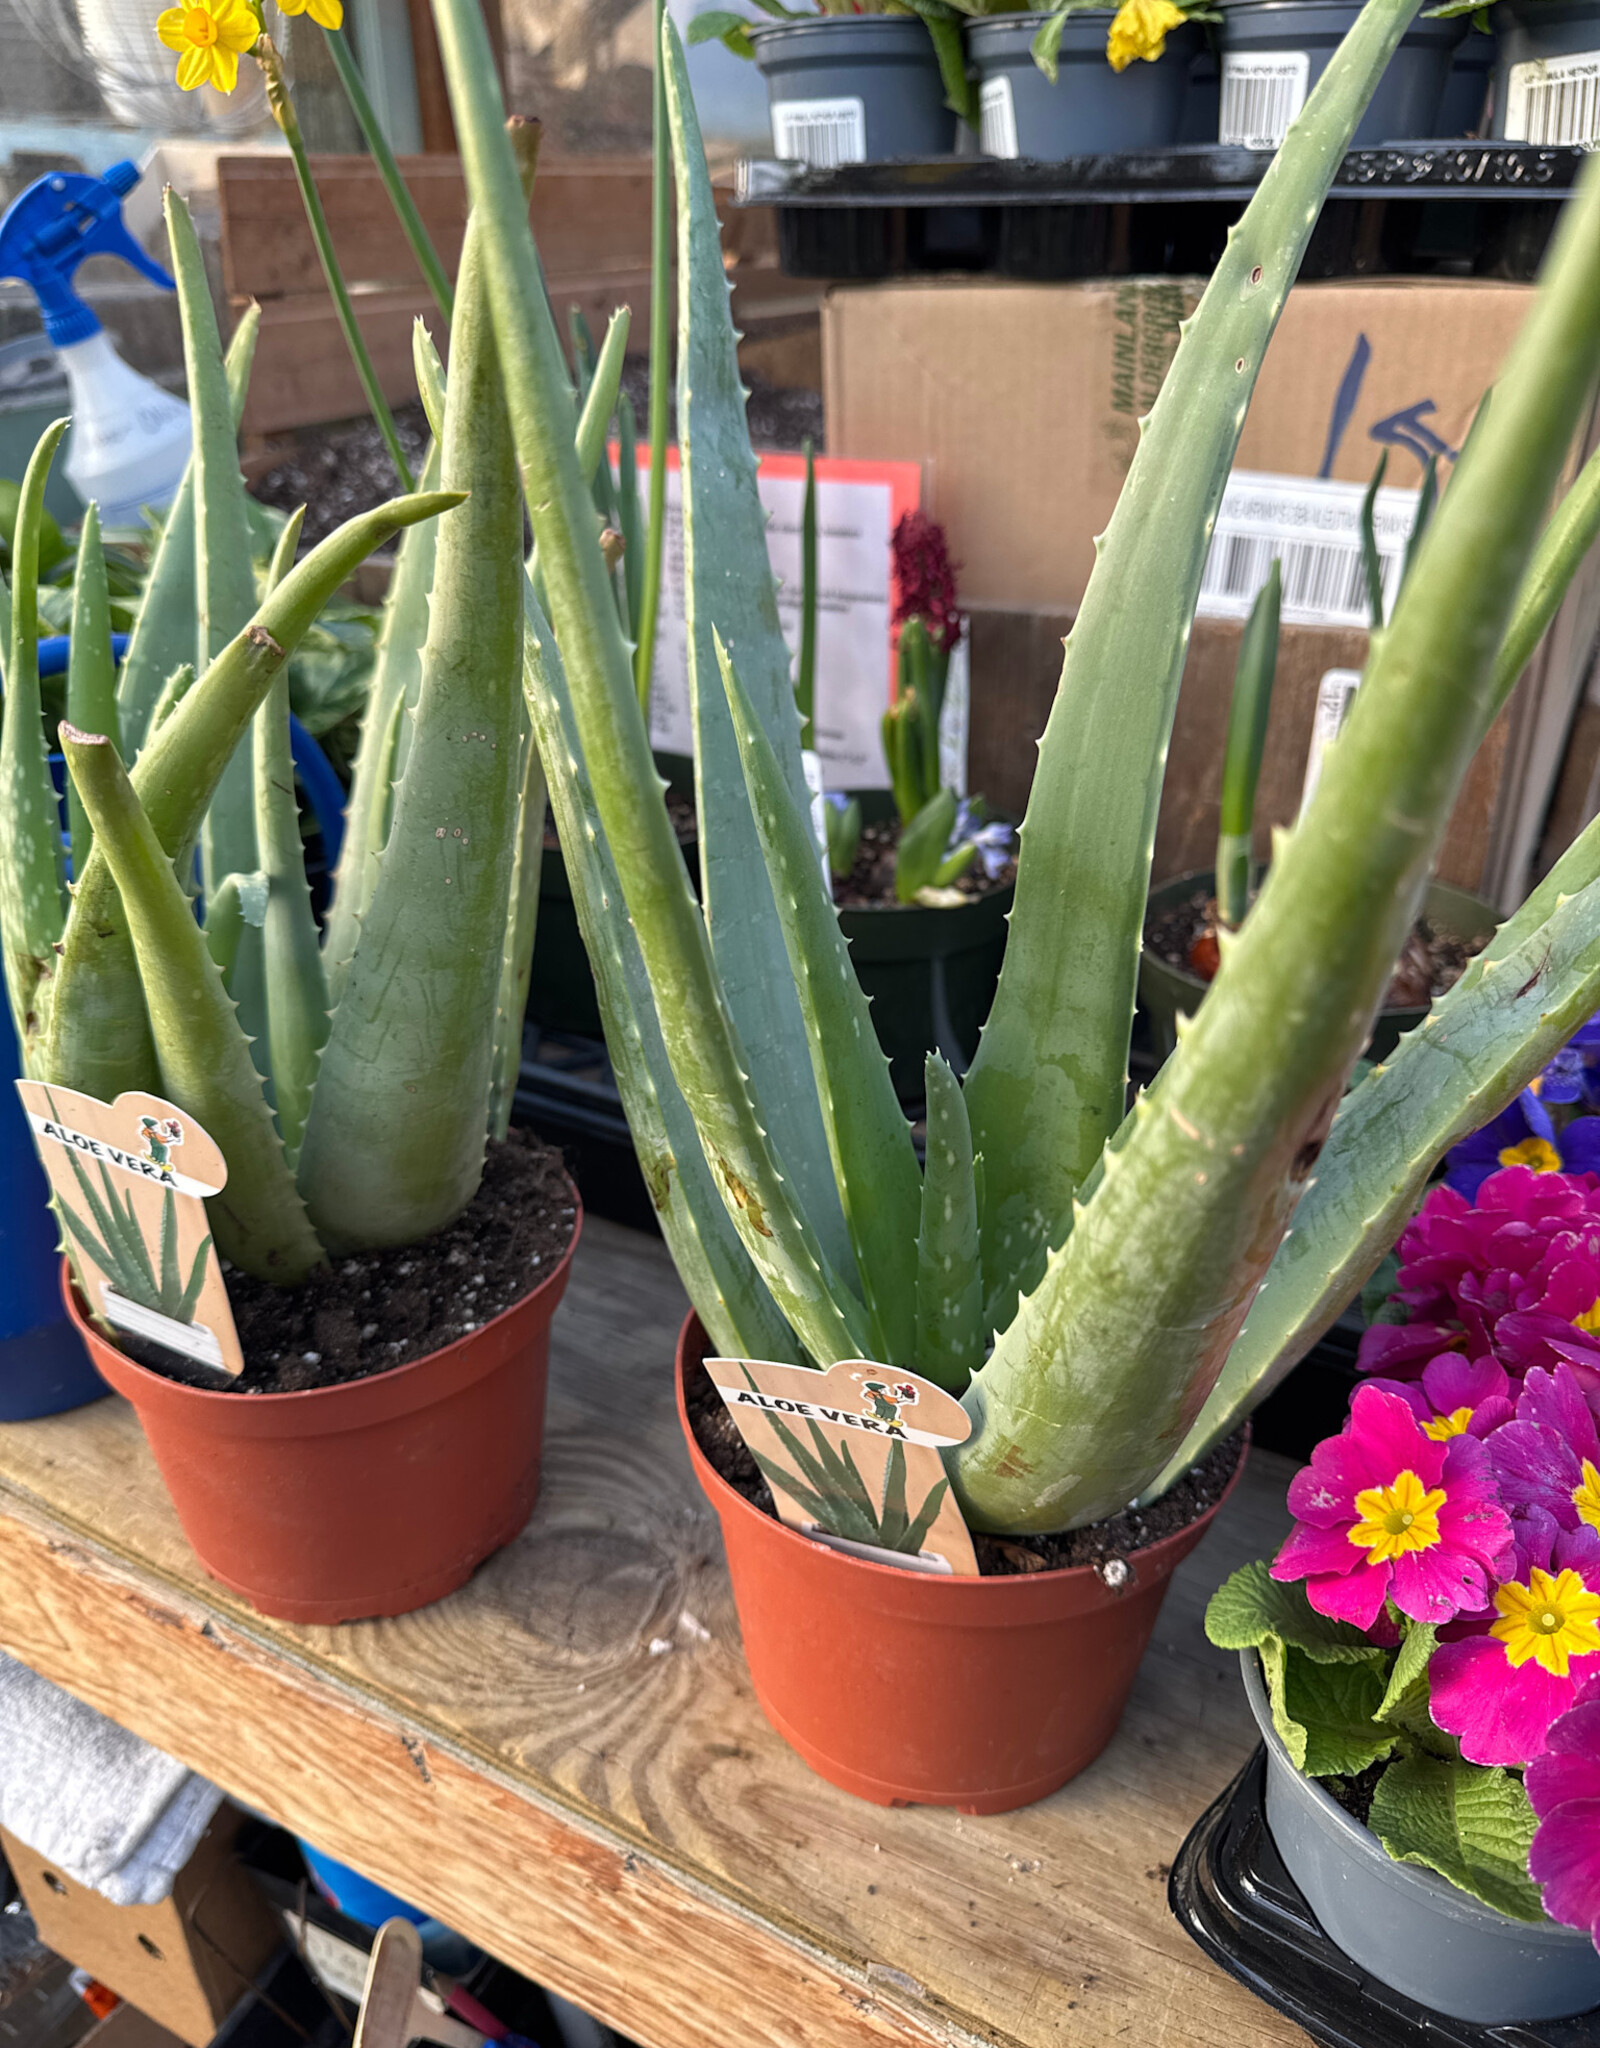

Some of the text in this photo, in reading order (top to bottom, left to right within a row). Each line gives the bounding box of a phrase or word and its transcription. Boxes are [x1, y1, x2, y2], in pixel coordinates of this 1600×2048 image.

[43, 1121, 179, 1188] ALOE VERA
[737, 1391, 909, 1440] ALOE VERA
